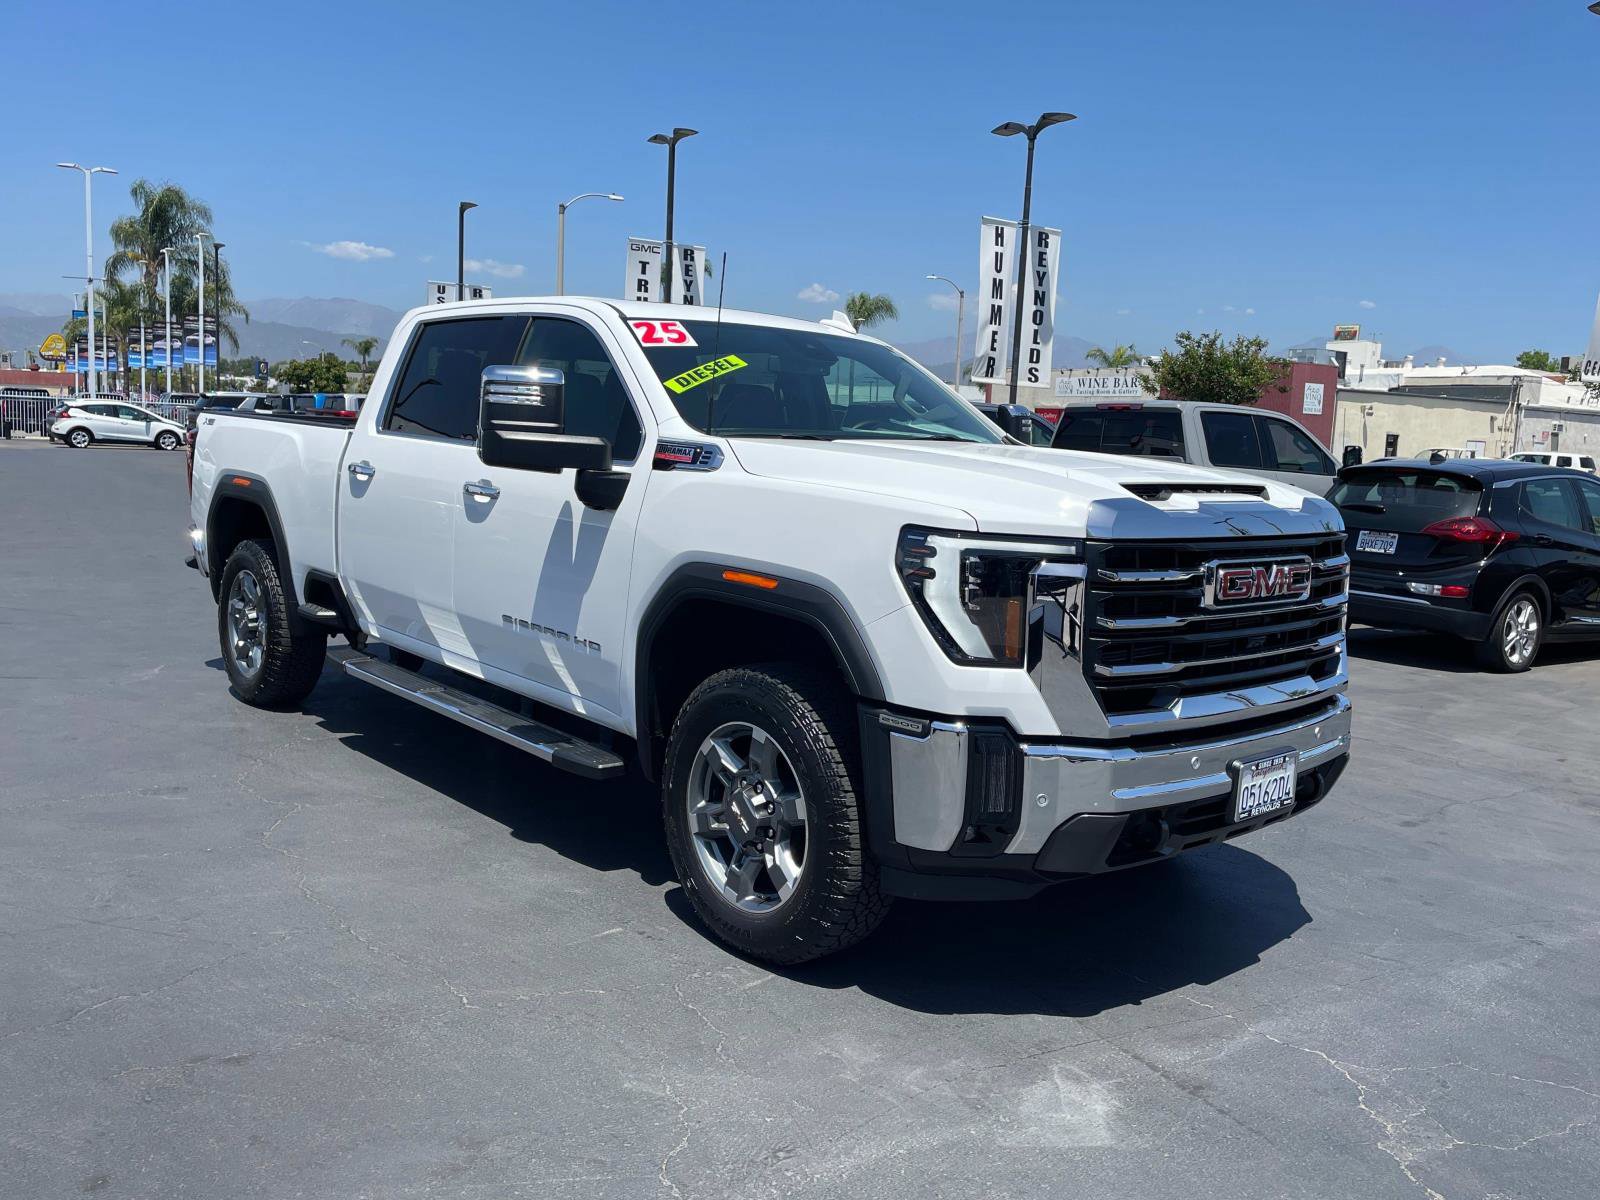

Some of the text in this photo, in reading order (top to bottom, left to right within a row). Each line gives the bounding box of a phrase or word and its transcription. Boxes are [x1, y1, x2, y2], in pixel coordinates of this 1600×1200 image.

[630, 243, 661, 255] GMC
[985, 225, 1004, 378] HUMMER
[1028, 231, 1049, 383] REYNOLDS
[632, 321, 688, 344] 25
[673, 358, 739, 388] DIESEL
[1077, 377, 1138, 389] WINE BAR
[1218, 564, 1310, 599] GMC
